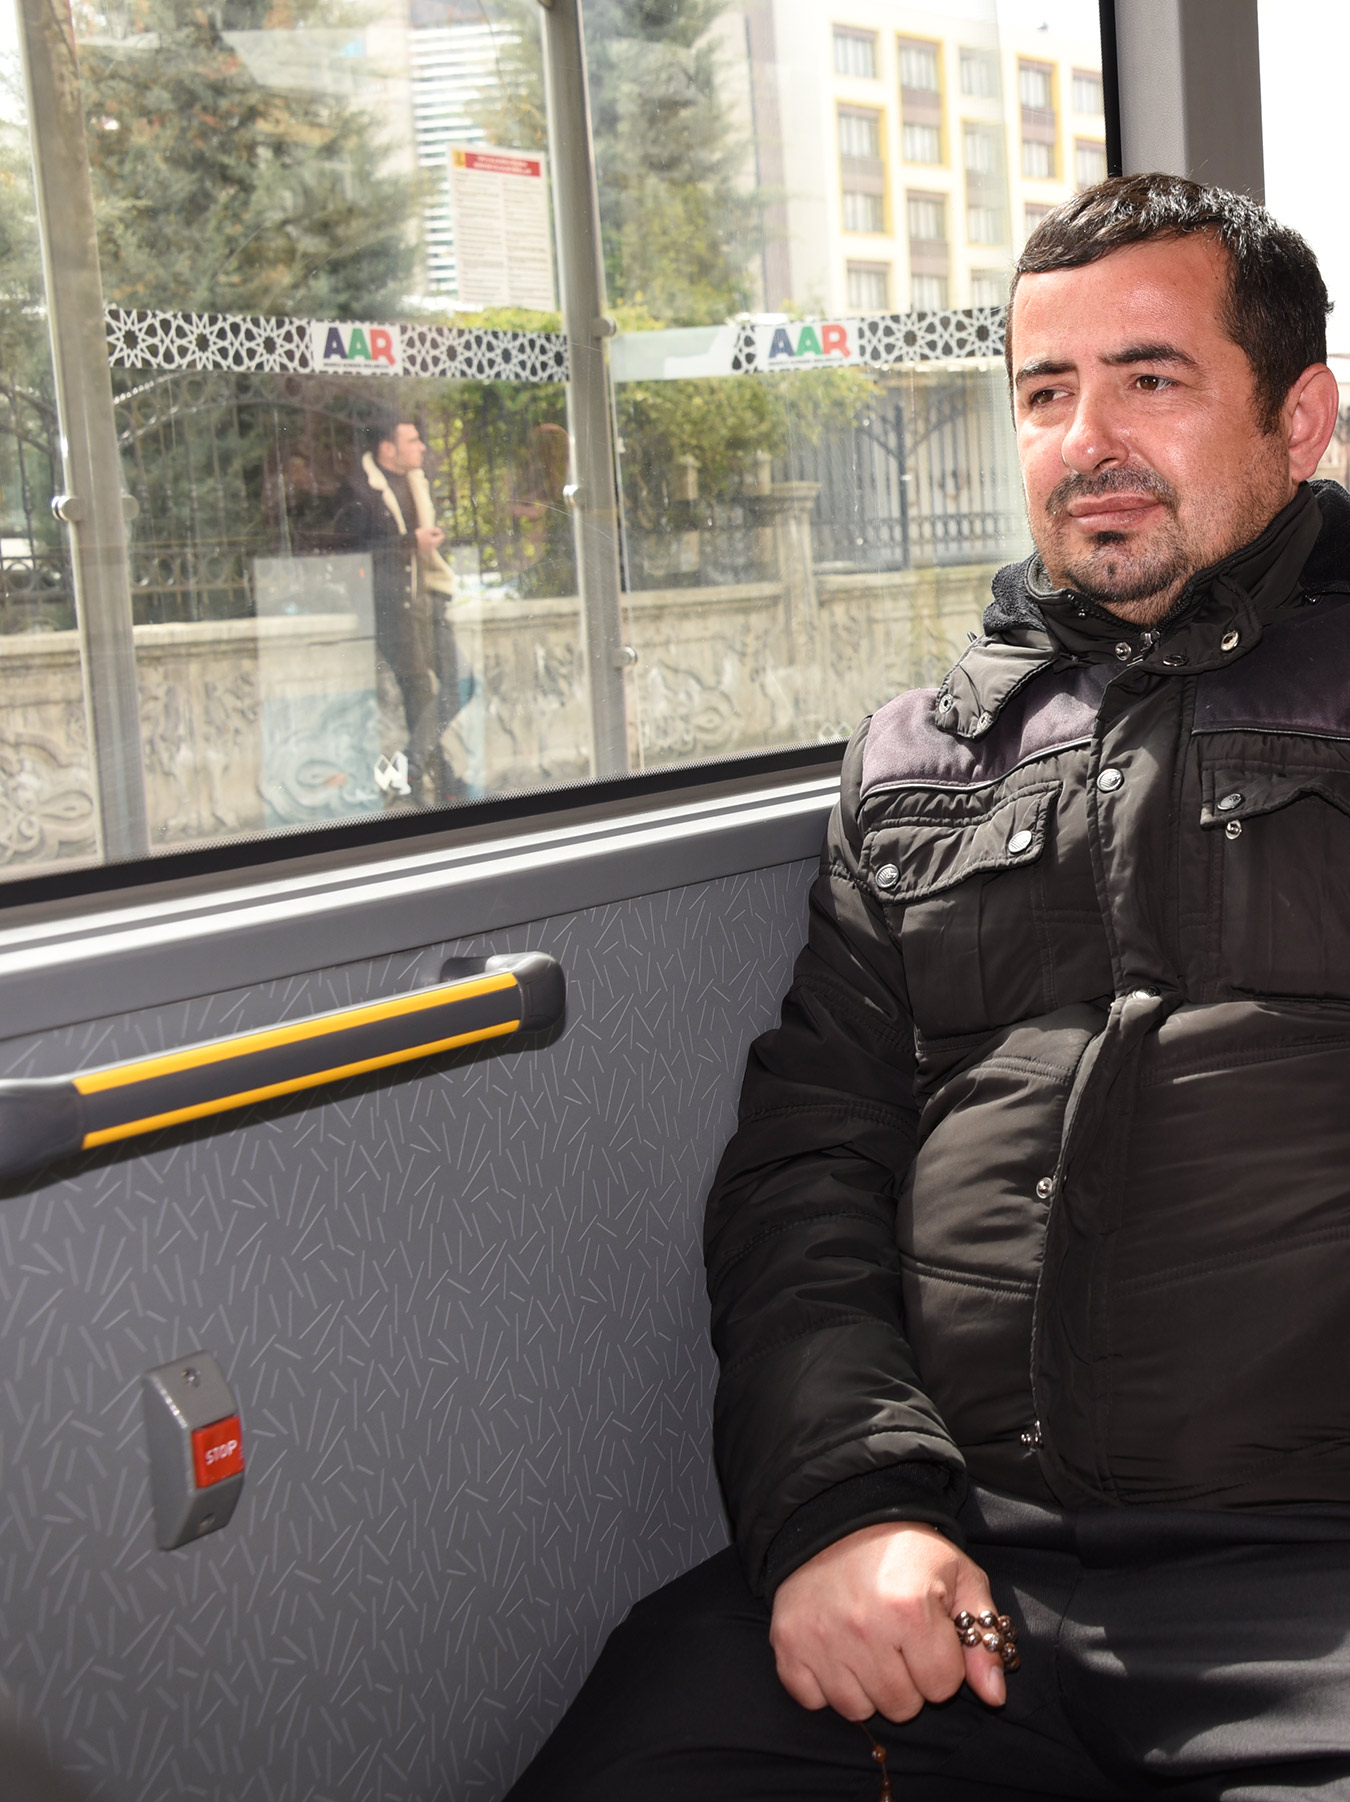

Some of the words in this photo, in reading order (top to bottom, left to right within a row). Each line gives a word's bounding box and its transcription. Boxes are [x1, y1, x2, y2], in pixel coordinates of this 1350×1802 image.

[324, 327, 396, 366] AAR
[769, 324, 851, 358] AAR
[205, 1440, 238, 1465] STOP
